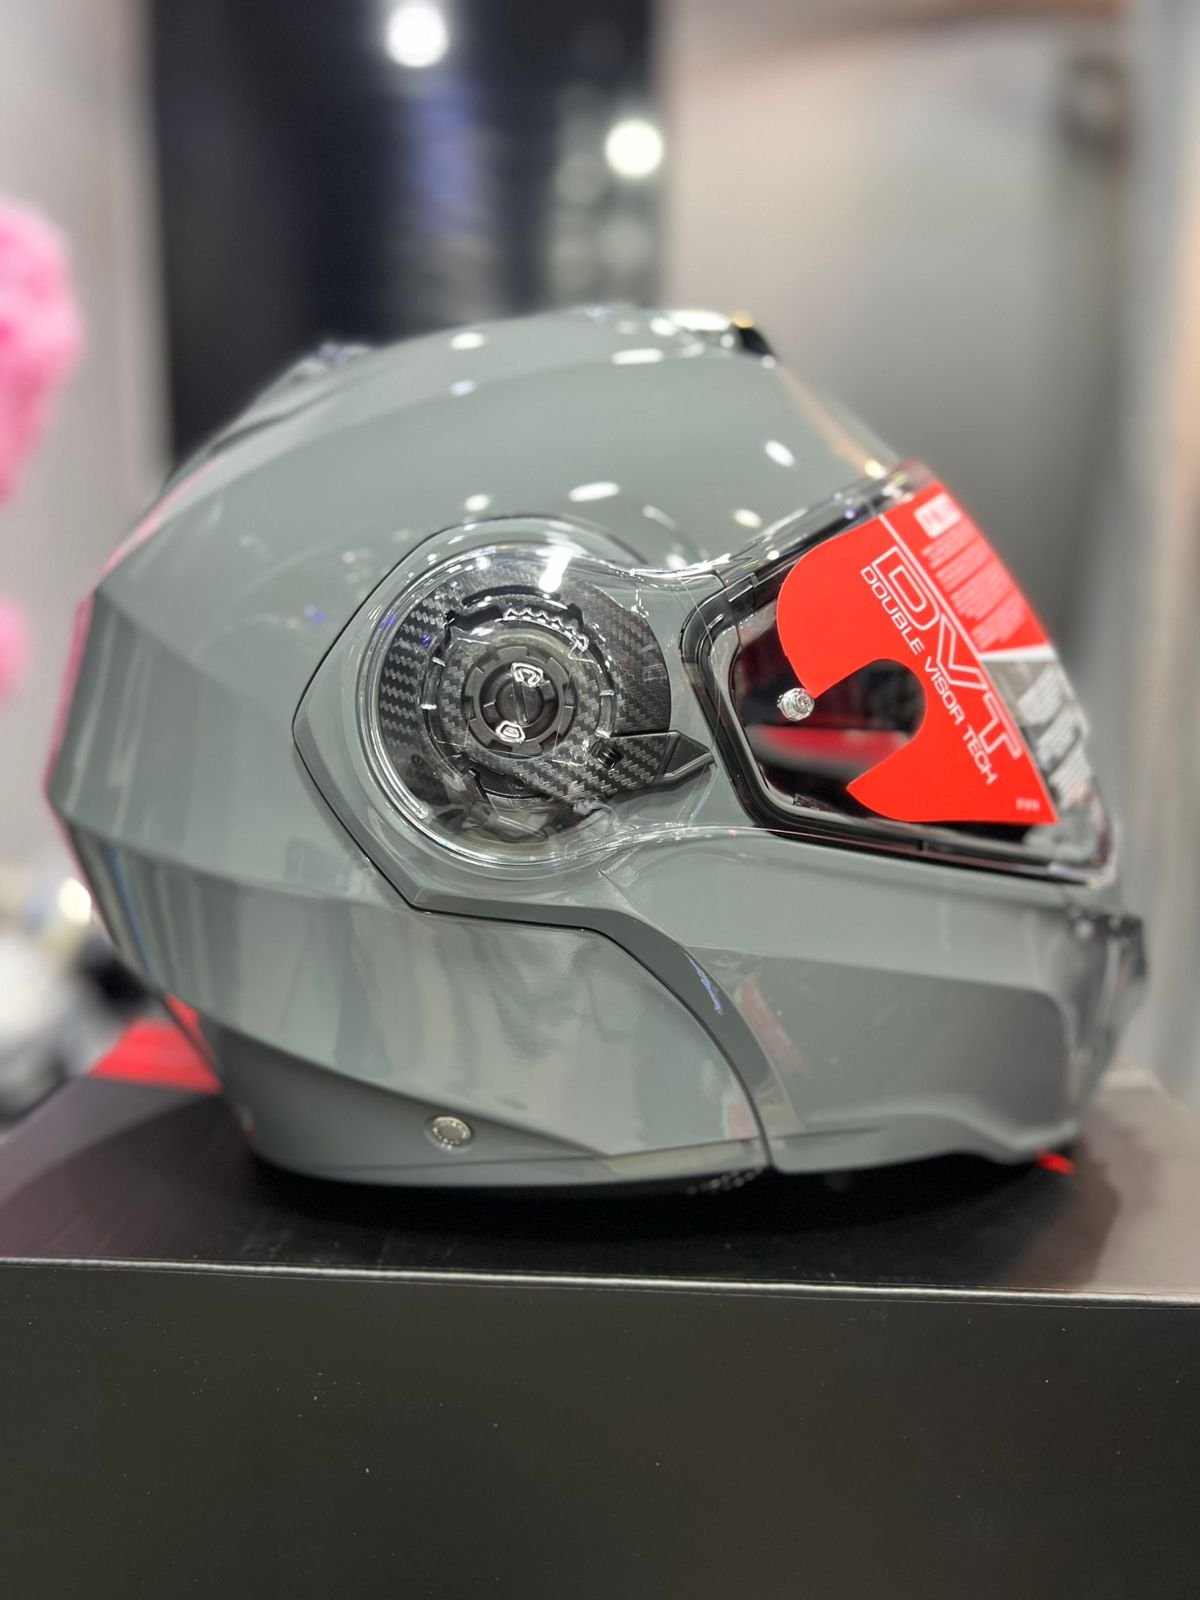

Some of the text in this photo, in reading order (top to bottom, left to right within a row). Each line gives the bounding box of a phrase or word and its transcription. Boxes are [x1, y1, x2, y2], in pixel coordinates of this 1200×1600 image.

[860, 566, 998, 785] DOUBLE VISOR TECH
[872, 546, 1023, 759] DVT
